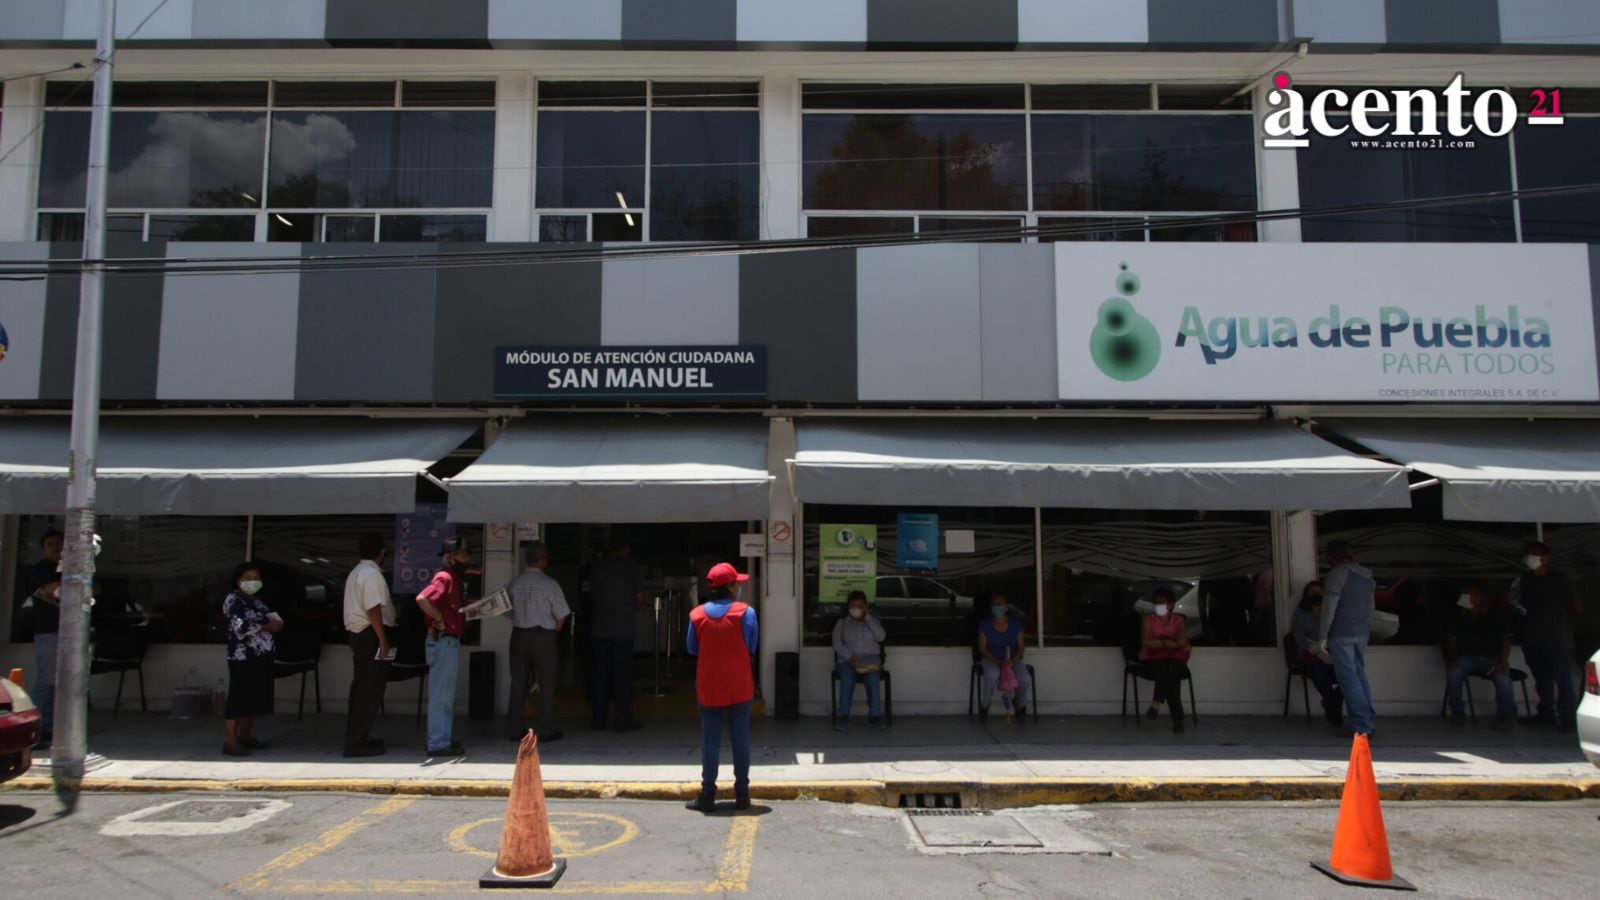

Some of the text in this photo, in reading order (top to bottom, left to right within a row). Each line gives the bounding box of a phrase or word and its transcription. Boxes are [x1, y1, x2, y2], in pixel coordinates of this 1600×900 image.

[1175, 304, 1551, 364] Agua de Puebla
[506, 350, 755, 364] MÓDULO DE ATENCIÓN CIUDADANA
[1382, 352, 1555, 375] PARA TODOS
[547, 367, 713, 388] SAN MANUEL
[1378, 388, 1446, 398] CONCESIONES
[1447, 388, 1506, 398] INTEGRALES
[1526, 388, 1540, 398] DE
